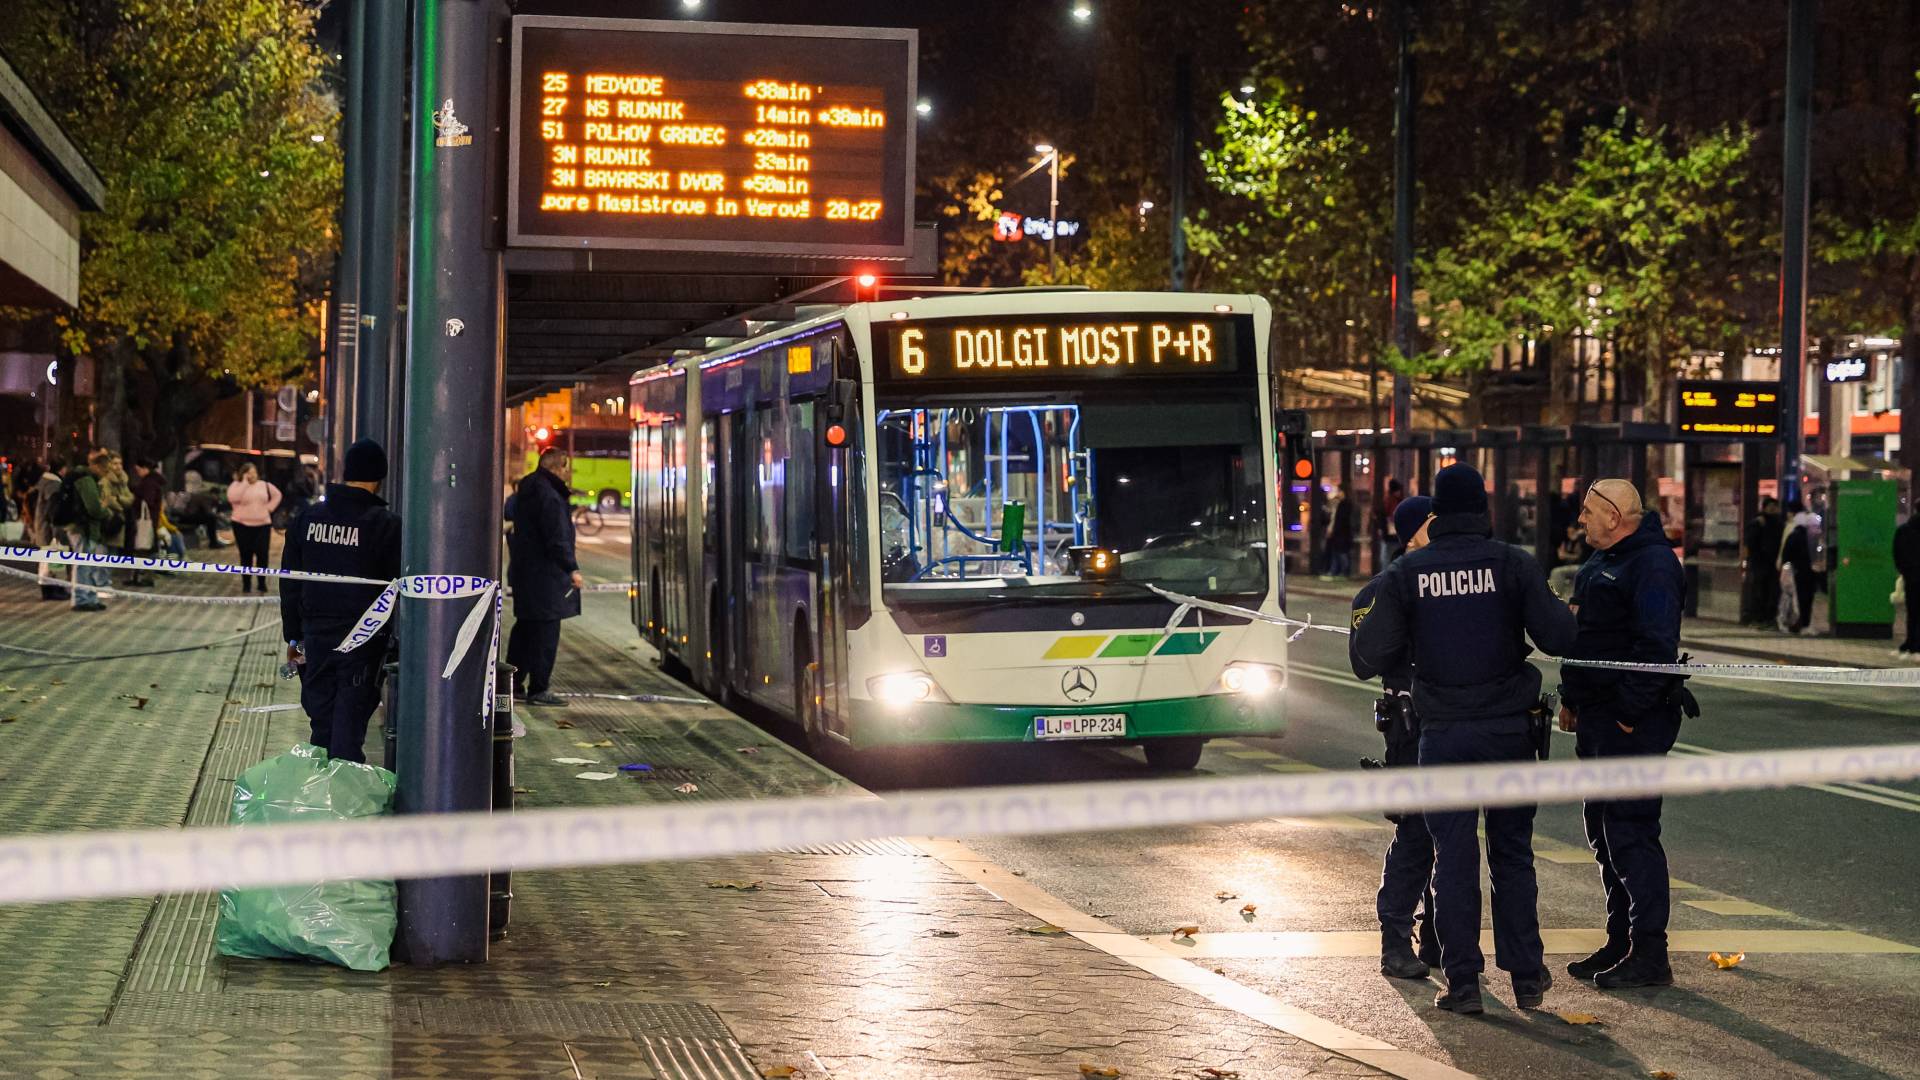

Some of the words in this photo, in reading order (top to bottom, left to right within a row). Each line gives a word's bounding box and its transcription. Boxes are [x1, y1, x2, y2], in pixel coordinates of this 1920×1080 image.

[542, 73, 568, 92] 25
[585, 75, 664, 96] MEDVODE
[542, 98, 568, 116] 27
[585, 100, 609, 117] NS
[617, 101, 684, 120] RUDNIK
[757, 106, 811, 125] 14min
[542, 121, 564, 139] 51
[659, 126, 726, 145] GRADEC
[553, 146, 577, 164] 3N
[584, 147, 652, 166] RUDNIK
[552, 169, 577, 187] 3N
[583, 170, 670, 190] BAVARSKI
[679, 173, 725, 192] DVOR
[597, 194, 707, 214] Magistrove
[716, 197, 738, 216] in
[826, 201, 882, 220] 20:27
[901, 329, 925, 374] 6
[954, 328, 1049, 369] DOLGI
[1061, 326, 1139, 366] MOST
[1152, 324, 1212, 364] P+R
[306, 522, 359, 547] POLICIJA
[413, 576, 465, 595] STOP
[1417, 568, 1496, 598] POLICIJA
[1046, 719, 1062, 734] LJ
